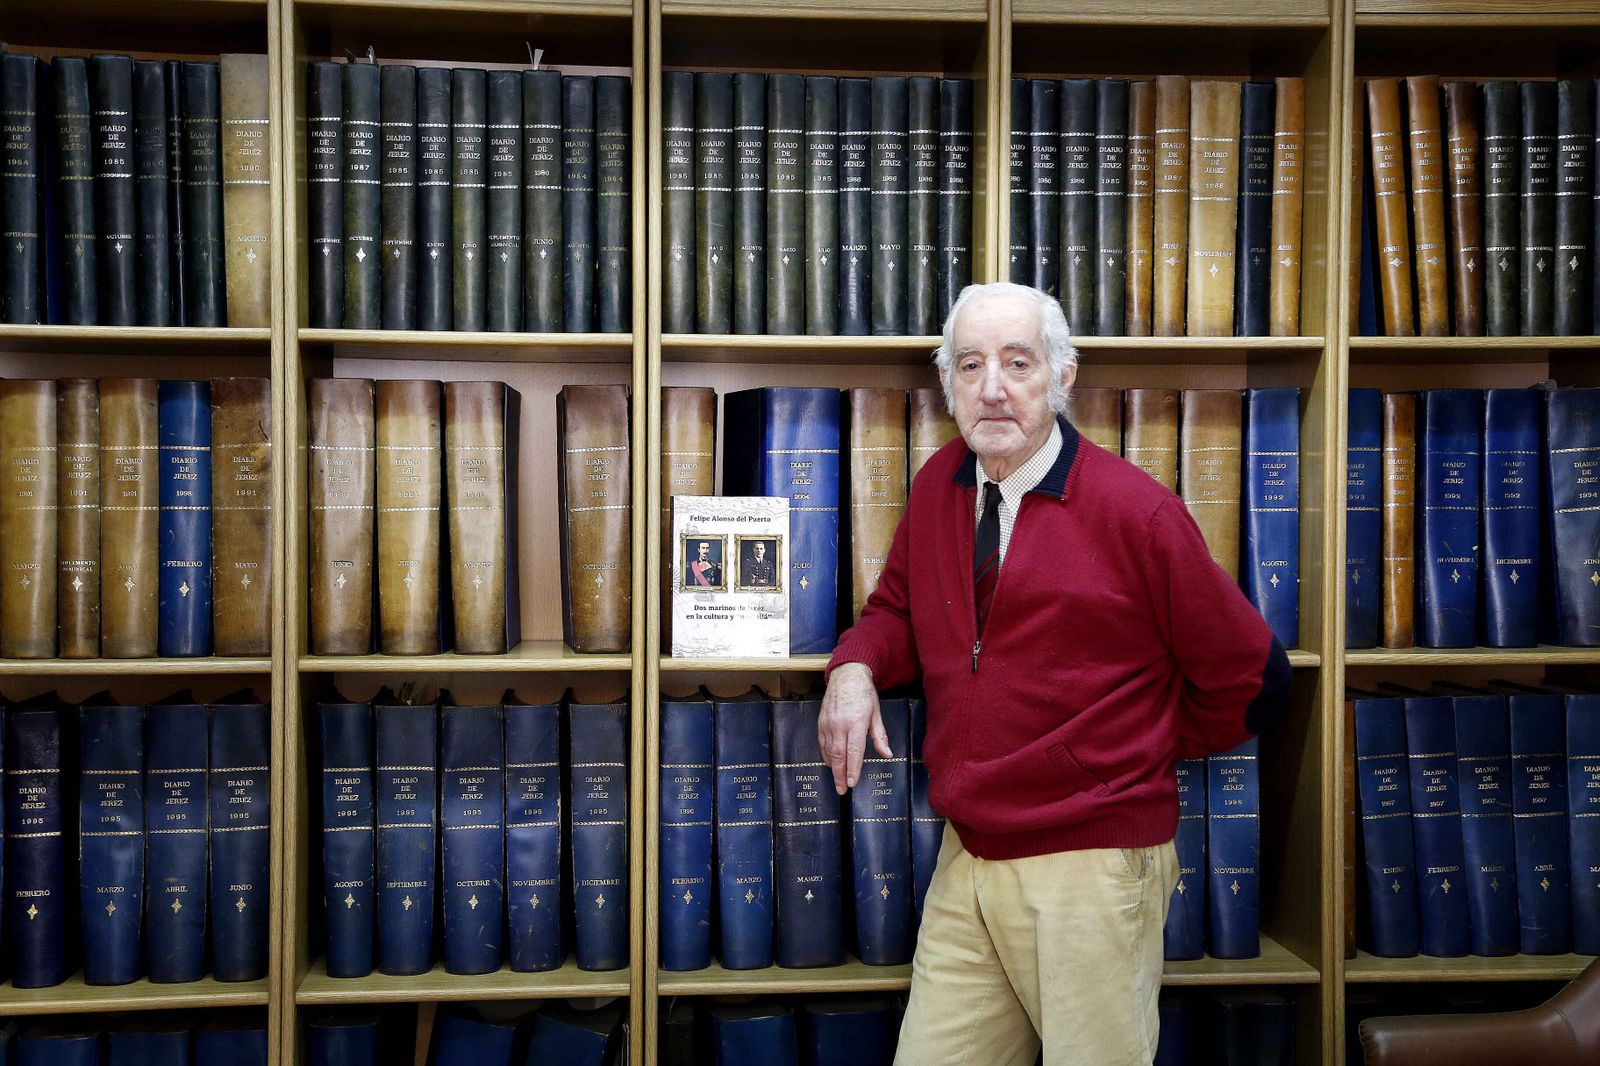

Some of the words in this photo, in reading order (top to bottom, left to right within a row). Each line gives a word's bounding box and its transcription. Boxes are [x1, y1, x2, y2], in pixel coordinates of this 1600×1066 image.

[690, 515, 710, 523] Felipe
[19, 787, 47, 795] DIARIO
[16, 889, 50, 897] FEBRERO
